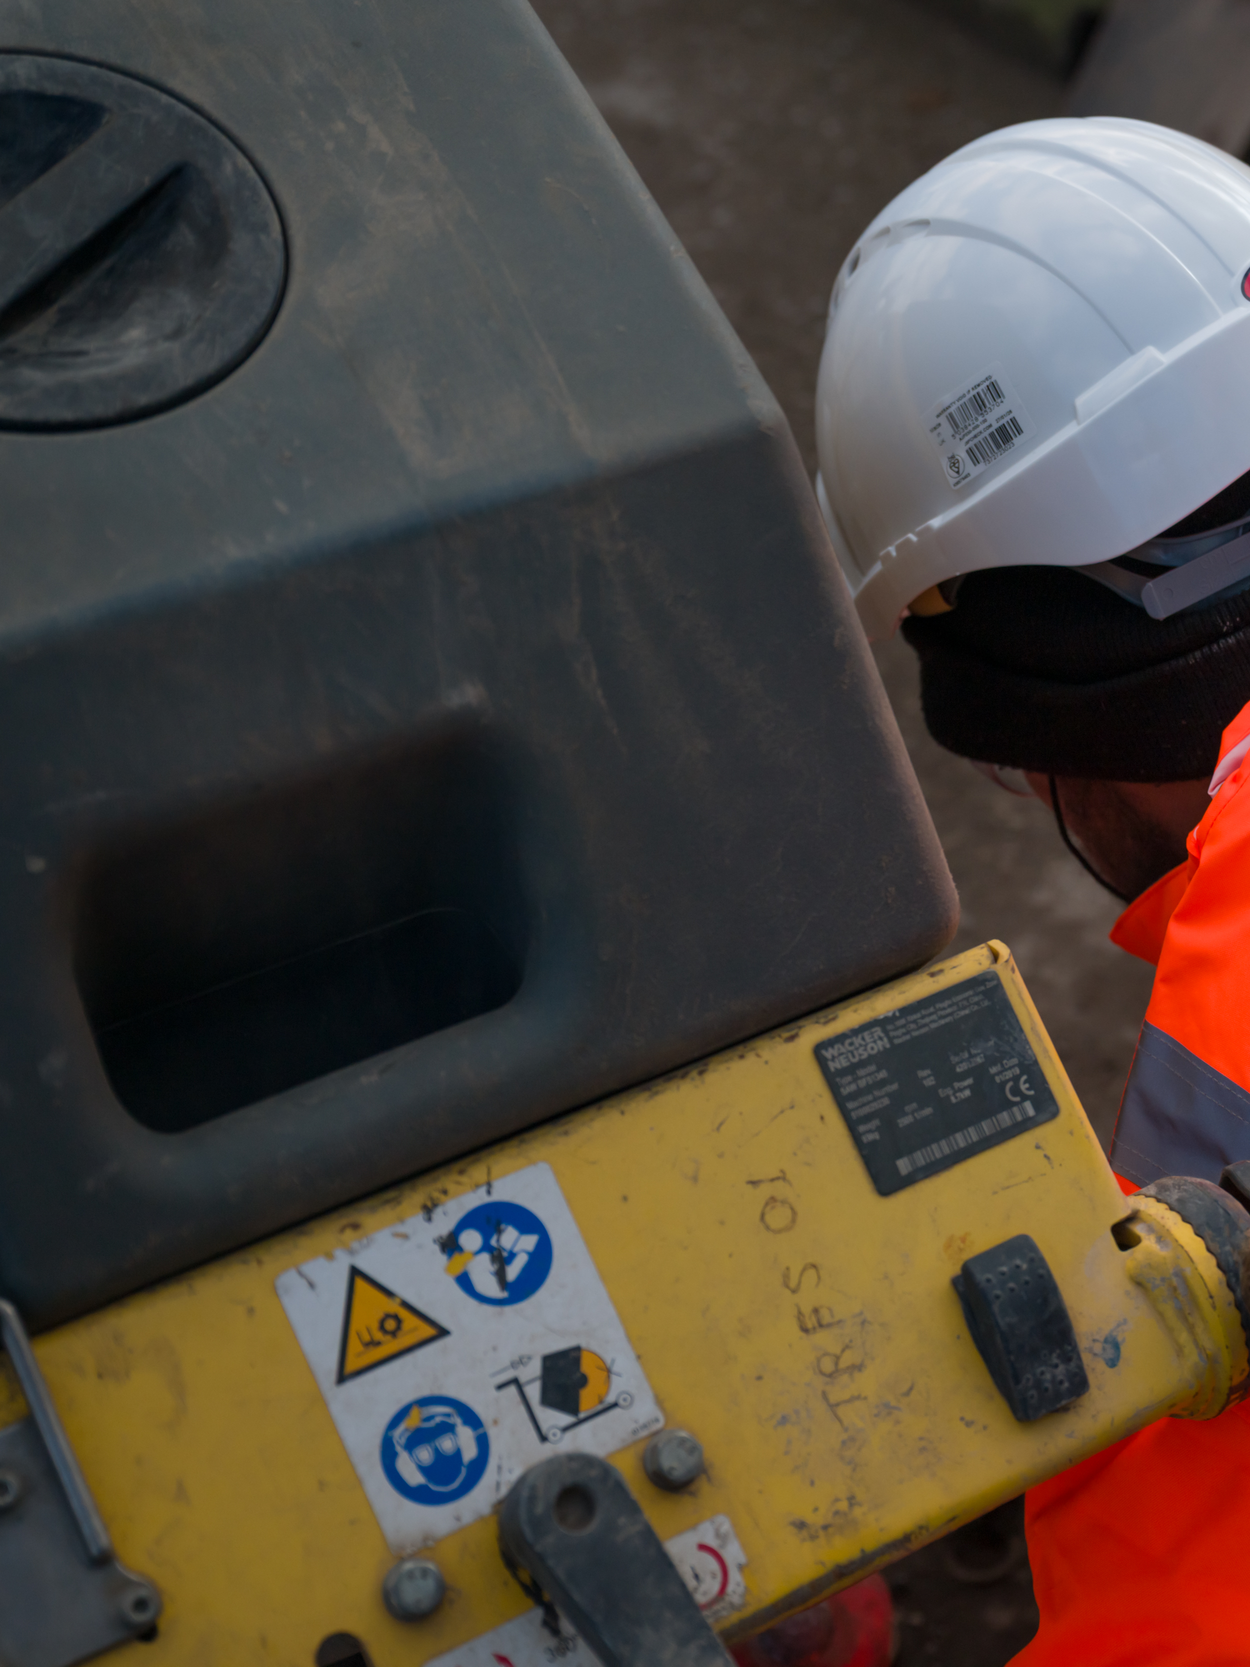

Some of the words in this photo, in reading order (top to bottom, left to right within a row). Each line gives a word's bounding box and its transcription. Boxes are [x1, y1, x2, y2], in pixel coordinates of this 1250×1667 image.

[822, 1027, 885, 1060] WACKER
[828, 1037, 890, 1071] NEUSON
[953, 1078, 973, 1090] Power
[1006, 1075, 1034, 1101] CE
